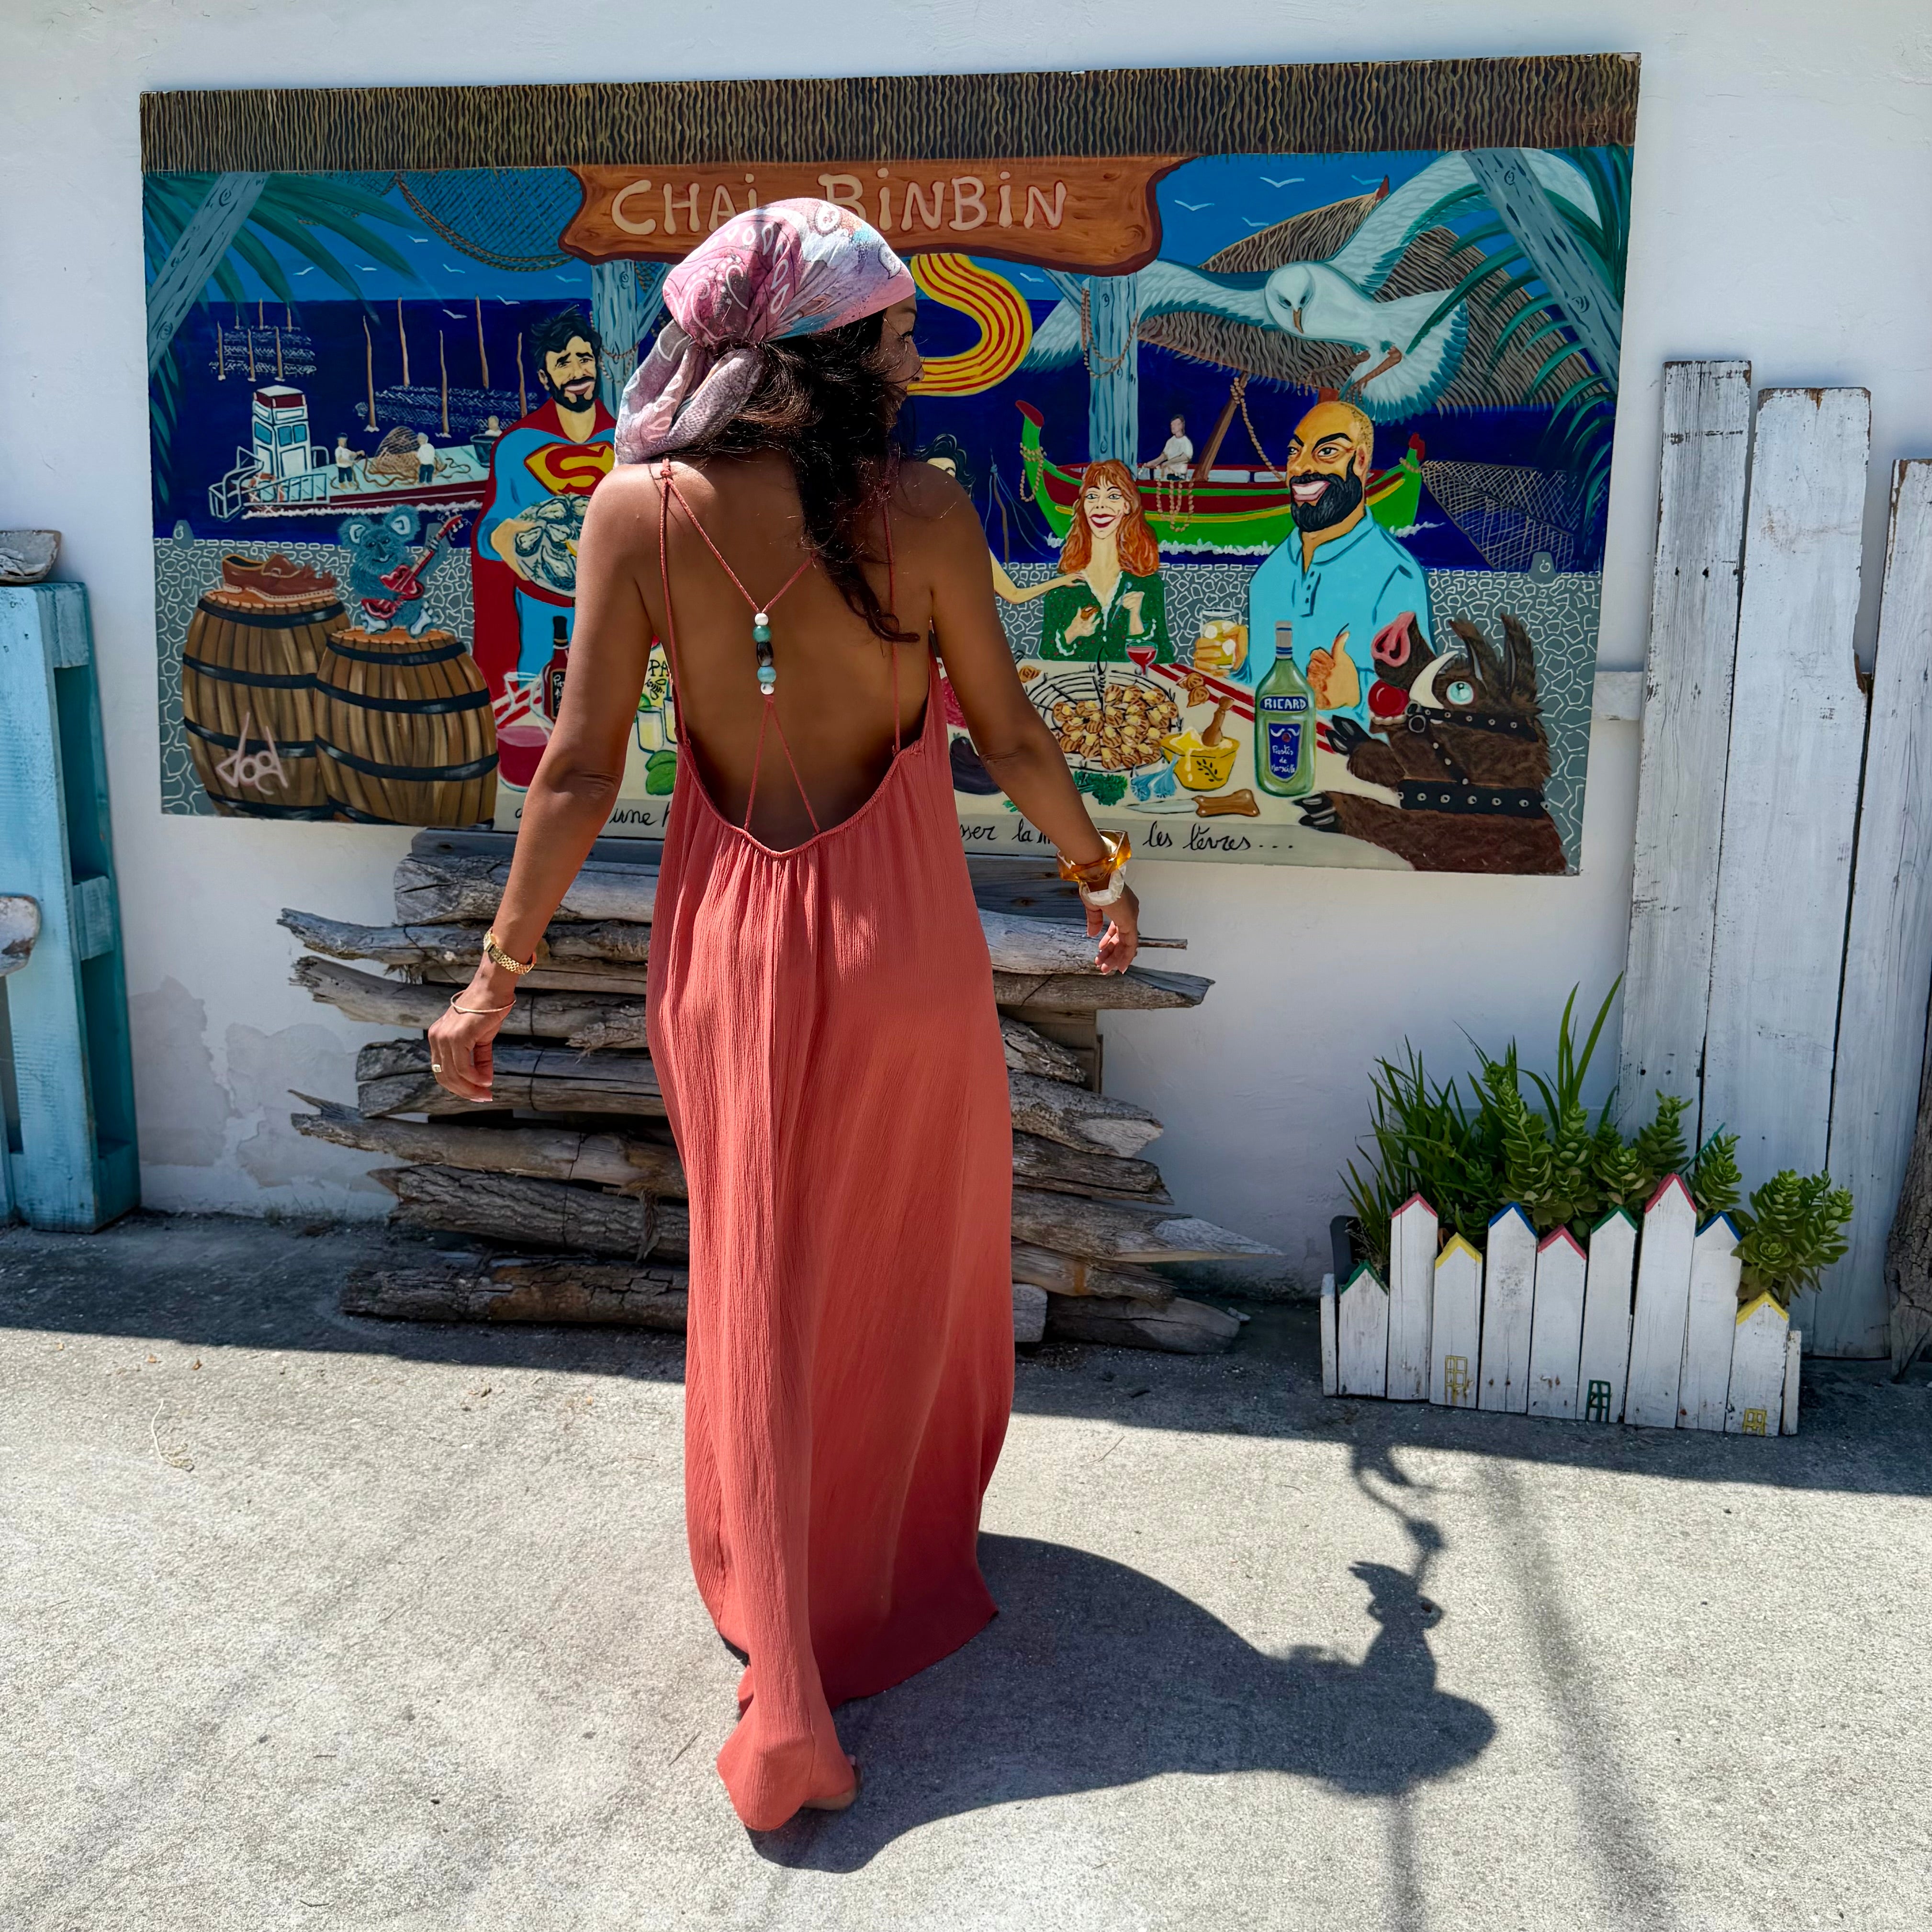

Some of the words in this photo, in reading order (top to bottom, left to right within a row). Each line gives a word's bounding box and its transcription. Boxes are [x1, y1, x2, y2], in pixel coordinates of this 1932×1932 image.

[1264, 698, 1307, 710] RICARD
[1011, 818, 1033, 842] la
[1142, 820, 1173, 848] les
